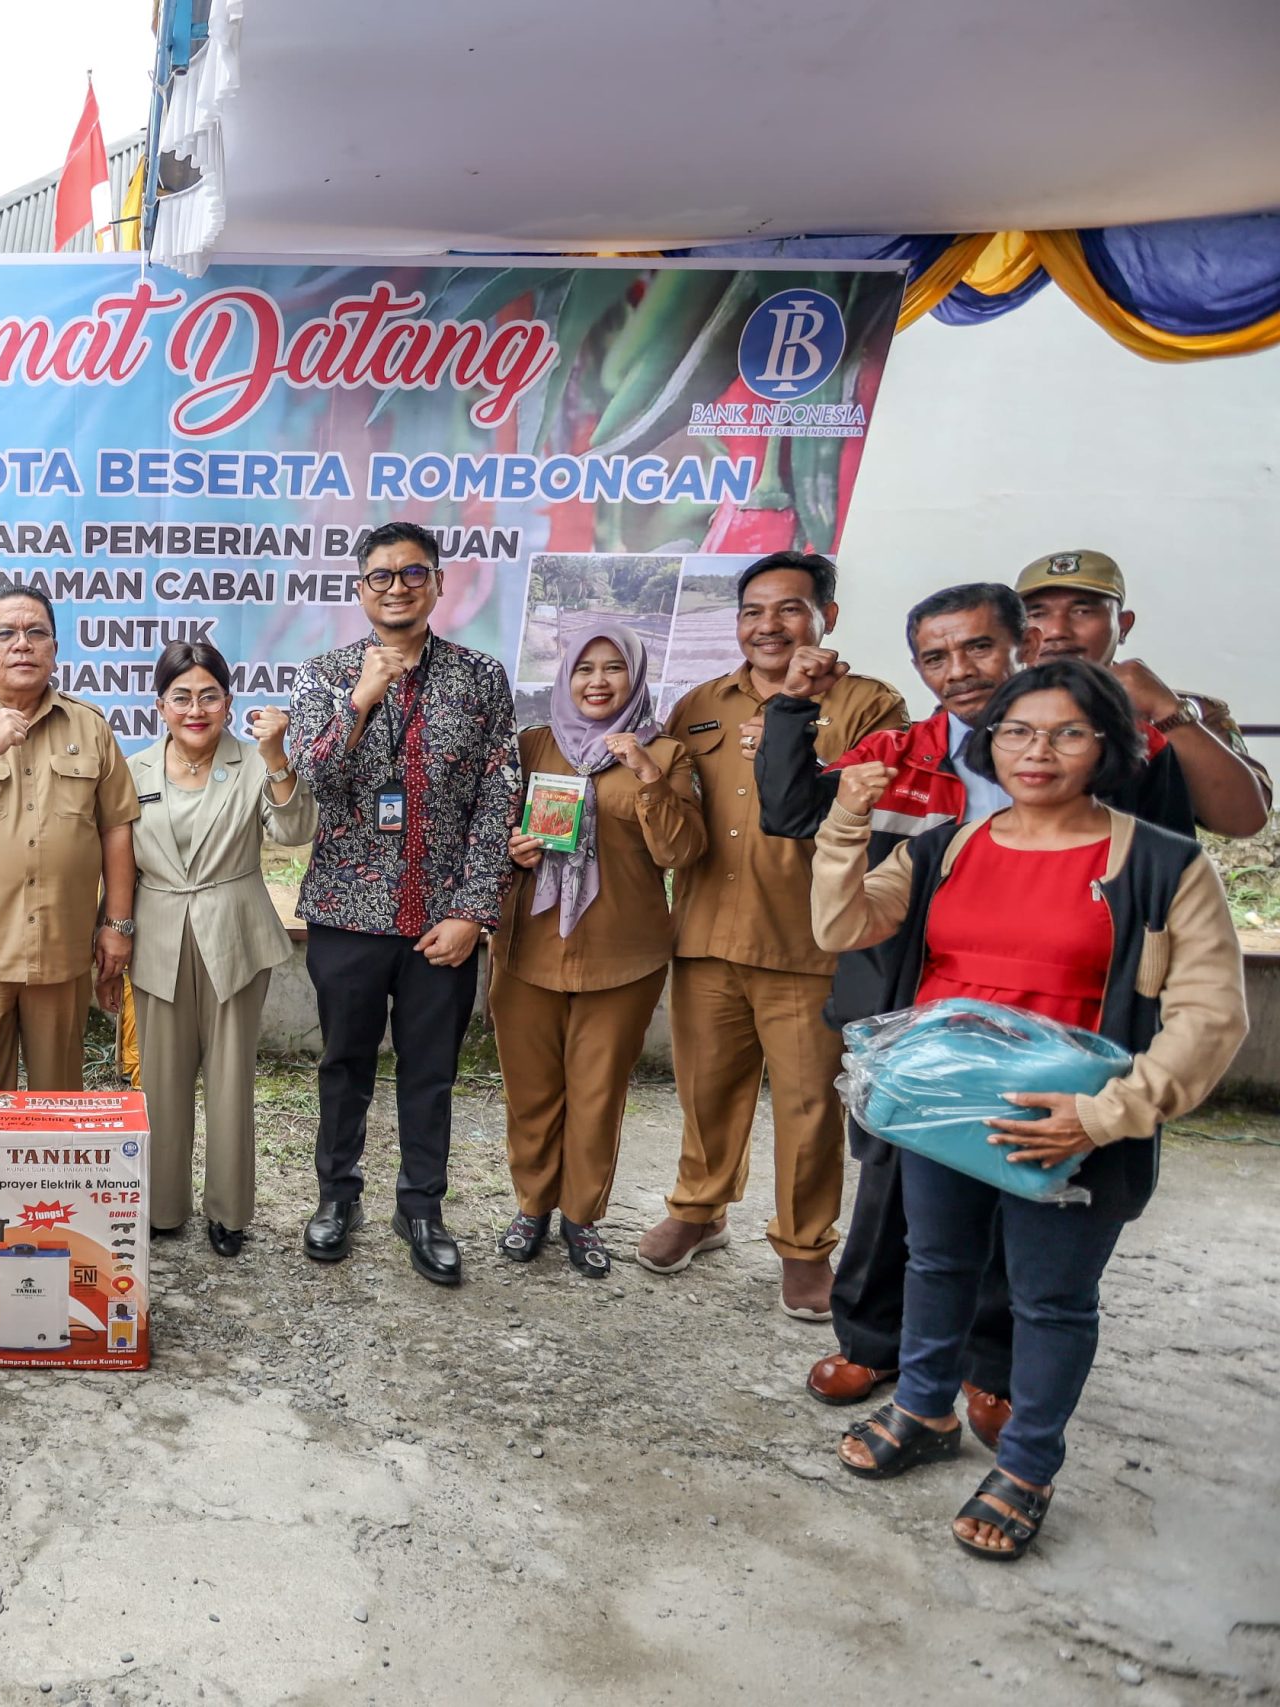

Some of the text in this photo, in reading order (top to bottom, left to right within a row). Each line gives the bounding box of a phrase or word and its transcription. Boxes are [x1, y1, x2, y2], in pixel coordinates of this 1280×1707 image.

[167, 281, 557, 438] Datang
[690, 404, 865, 425] BANK INDONESIA
[688, 426, 863, 436] BANK SENTRAL REPUBLIK INDONESIA
[98, 451, 354, 499] BESERTA
[370, 453, 756, 504] ROMBONGAN
[84, 525, 311, 557] PEMBERIAN
[324, 527, 519, 559] BAUAN
[155, 572, 275, 601] CABAI
[80, 619, 215, 648] UNTUK
[6, 1148, 112, 1165] TANIKU
[40, 1178, 82, 1189] Elektrik
[86, 1179, 93, 1189] &
[96, 1179, 141, 1189] Manual
[90, 1191, 141, 1204] 16-T2
[27, 1207, 64, 1222] 2 fungsi
[73, 1268, 97, 1285] SNI
[99, 1358, 133, 1366] Kuningan
